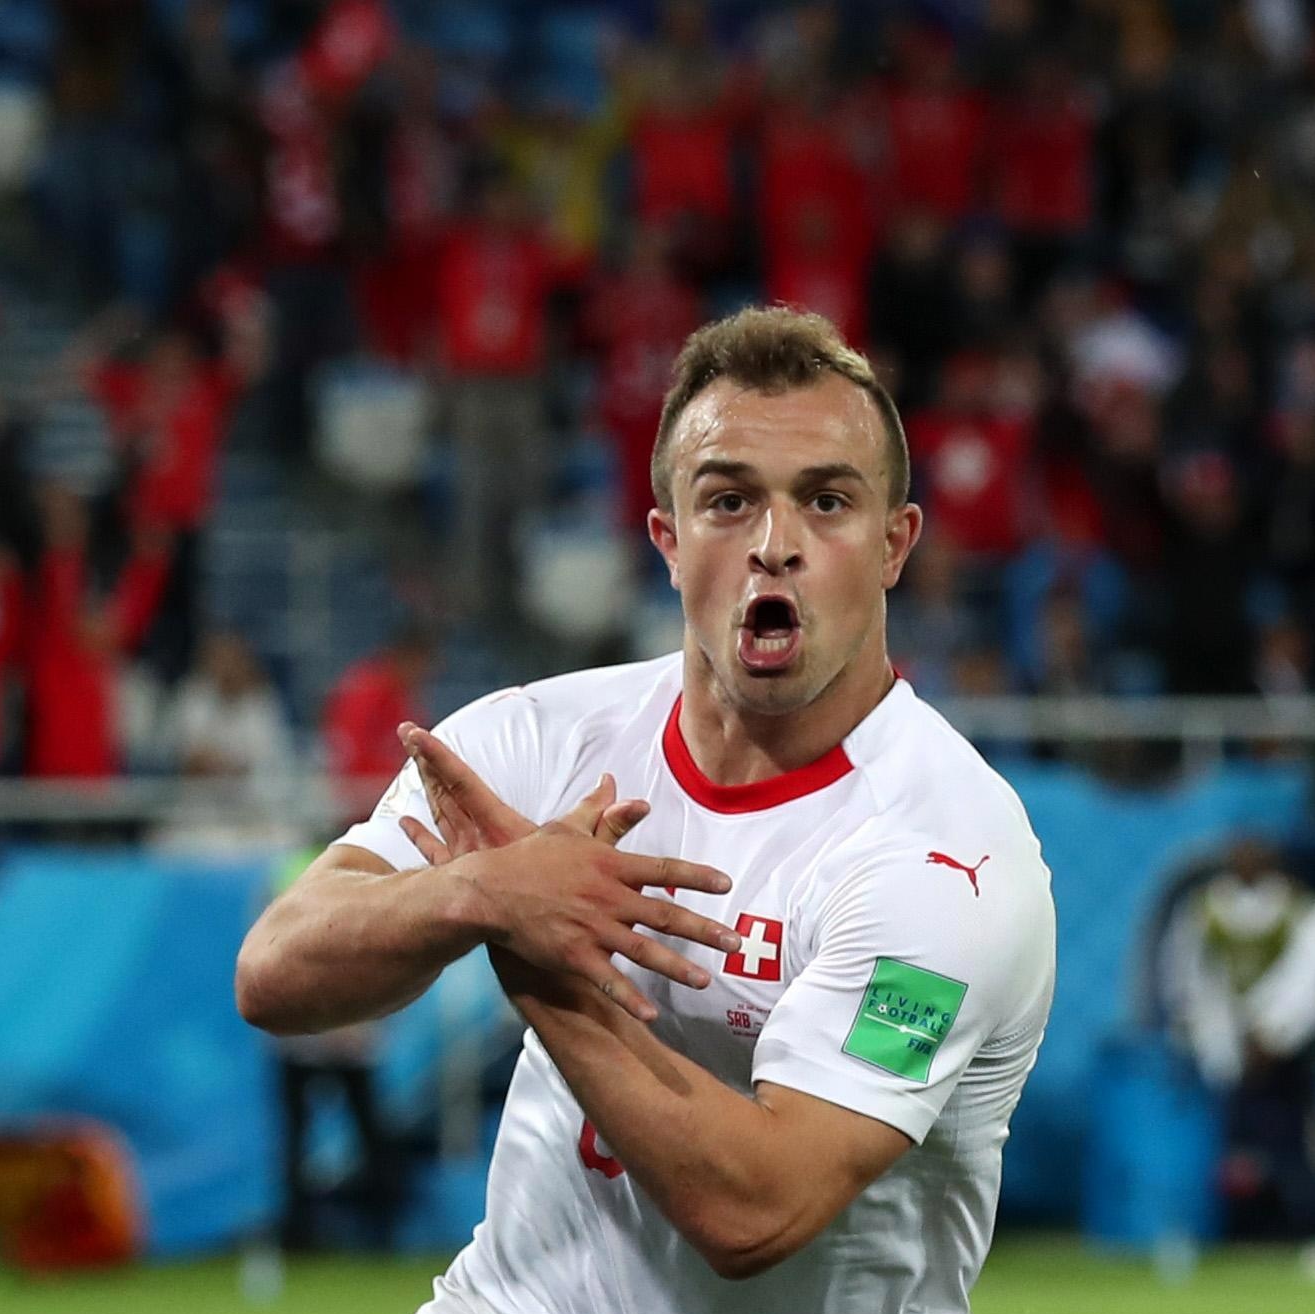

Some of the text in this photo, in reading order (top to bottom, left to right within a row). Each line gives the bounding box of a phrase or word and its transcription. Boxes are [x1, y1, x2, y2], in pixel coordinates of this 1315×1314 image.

[726, 1009, 751, 1029] SRB
[867, 999, 943, 1035] FOOTBALL
[871, 986, 951, 1024] LIVING
